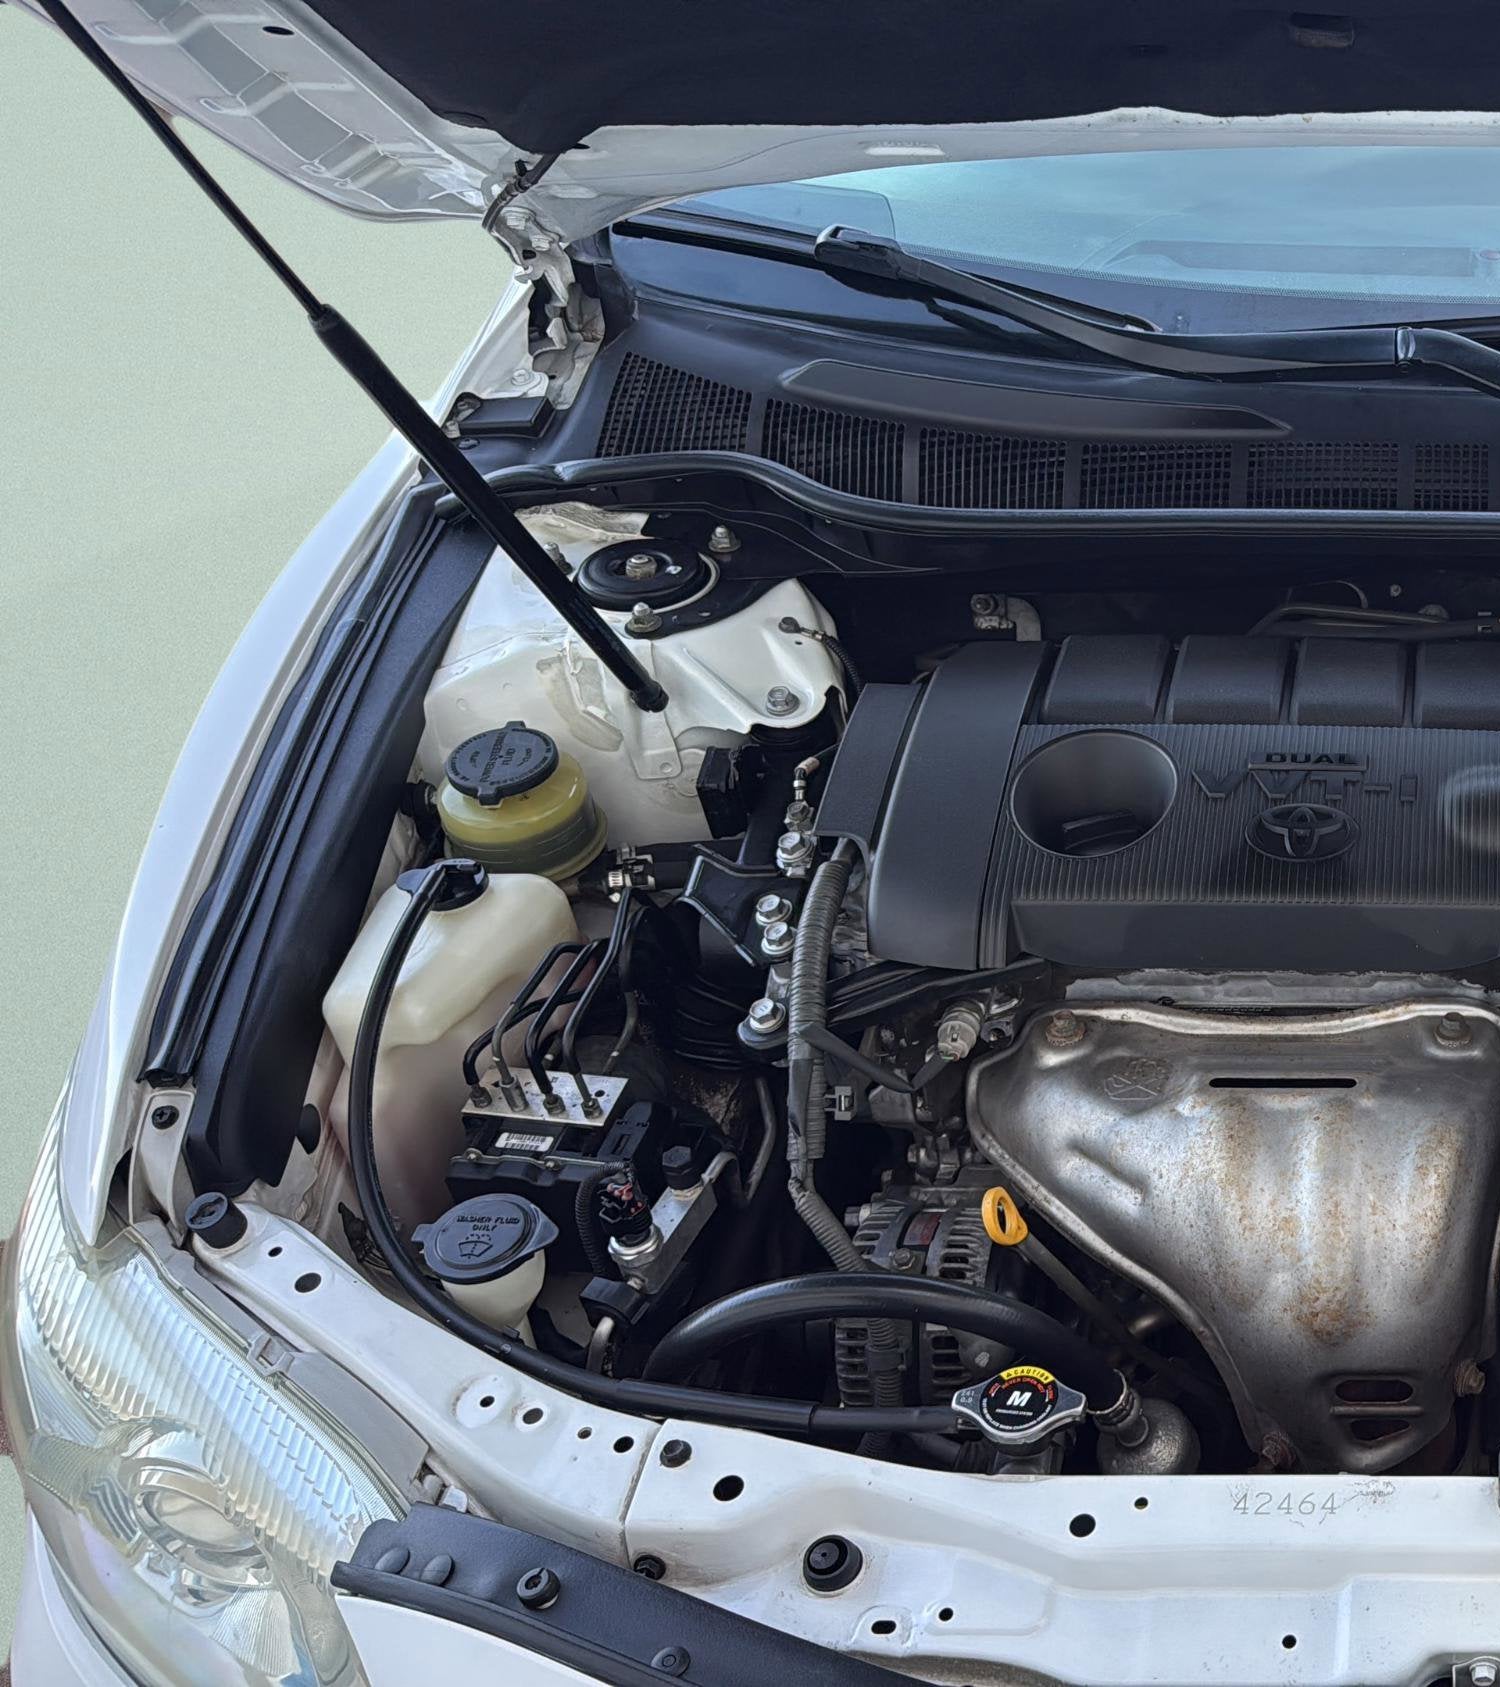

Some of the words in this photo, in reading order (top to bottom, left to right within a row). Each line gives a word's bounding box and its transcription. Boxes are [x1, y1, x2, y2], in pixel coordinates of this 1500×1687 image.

[1266, 753, 1360, 764] DUAL
[1013, 1367, 1050, 1381] CAUTION
[1006, 1390, 1033, 1407] M
[1232, 1492, 1337, 1515] 42464
